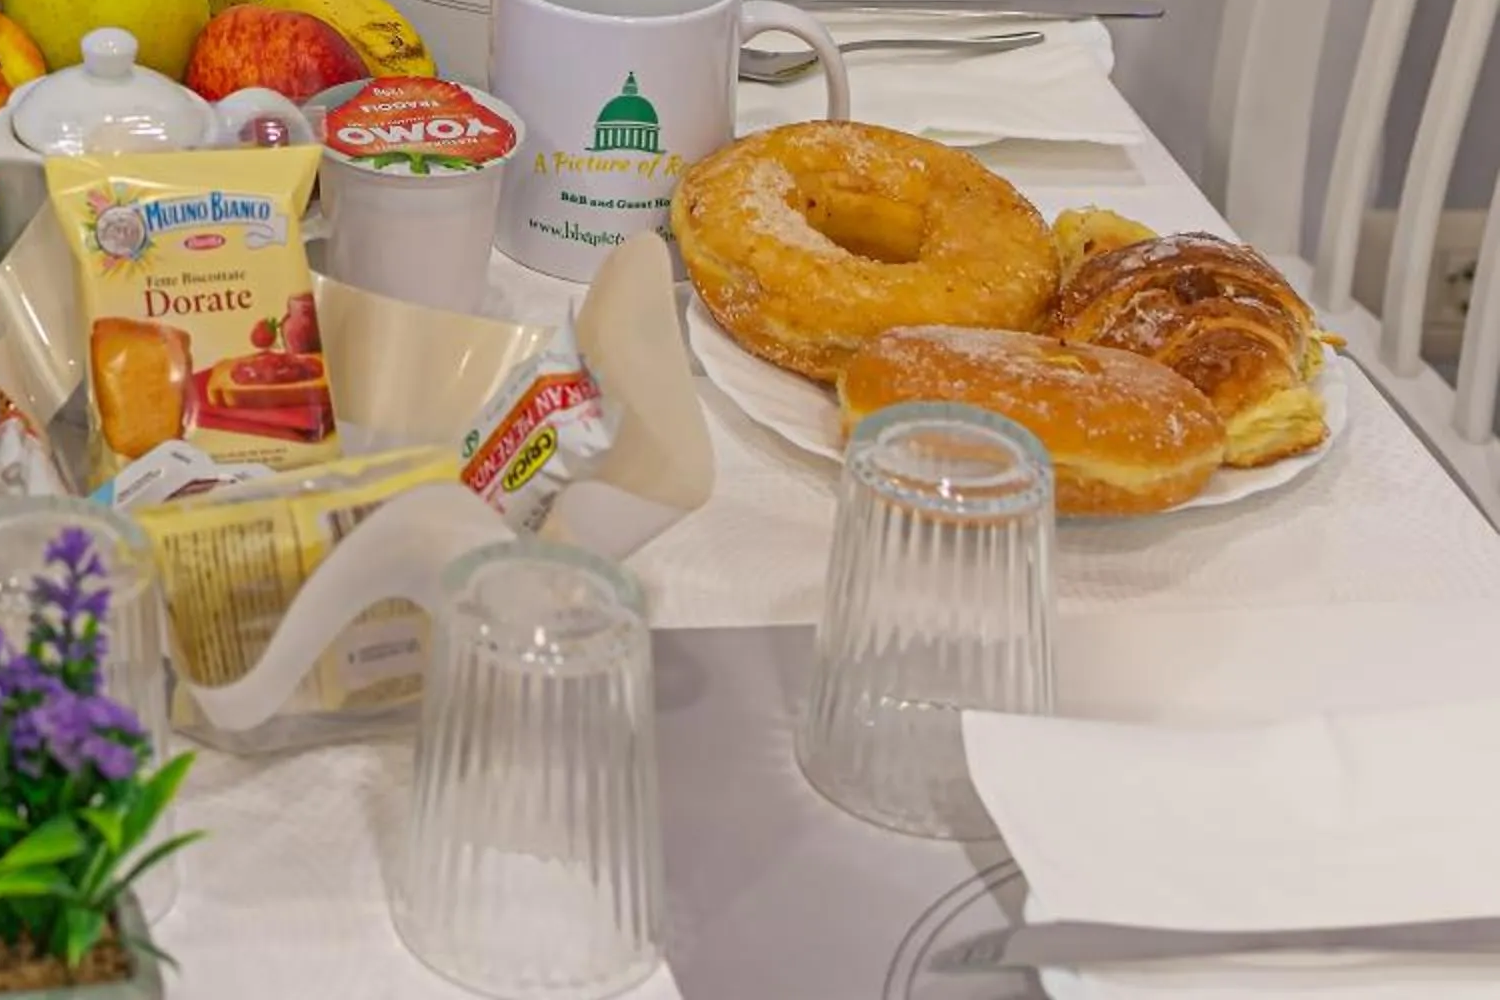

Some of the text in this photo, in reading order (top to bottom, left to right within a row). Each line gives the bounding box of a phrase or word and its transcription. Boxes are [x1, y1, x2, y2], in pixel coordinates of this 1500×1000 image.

[336, 117, 499, 146] YOMO
[553, 151, 630, 176] Picture
[145, 191, 271, 231] MULINO BIANCO
[590, 198, 614, 209] and
[616, 199, 651, 209] Guest
[144, 288, 253, 318] Dorate
[507, 432, 554, 487] CRICH
